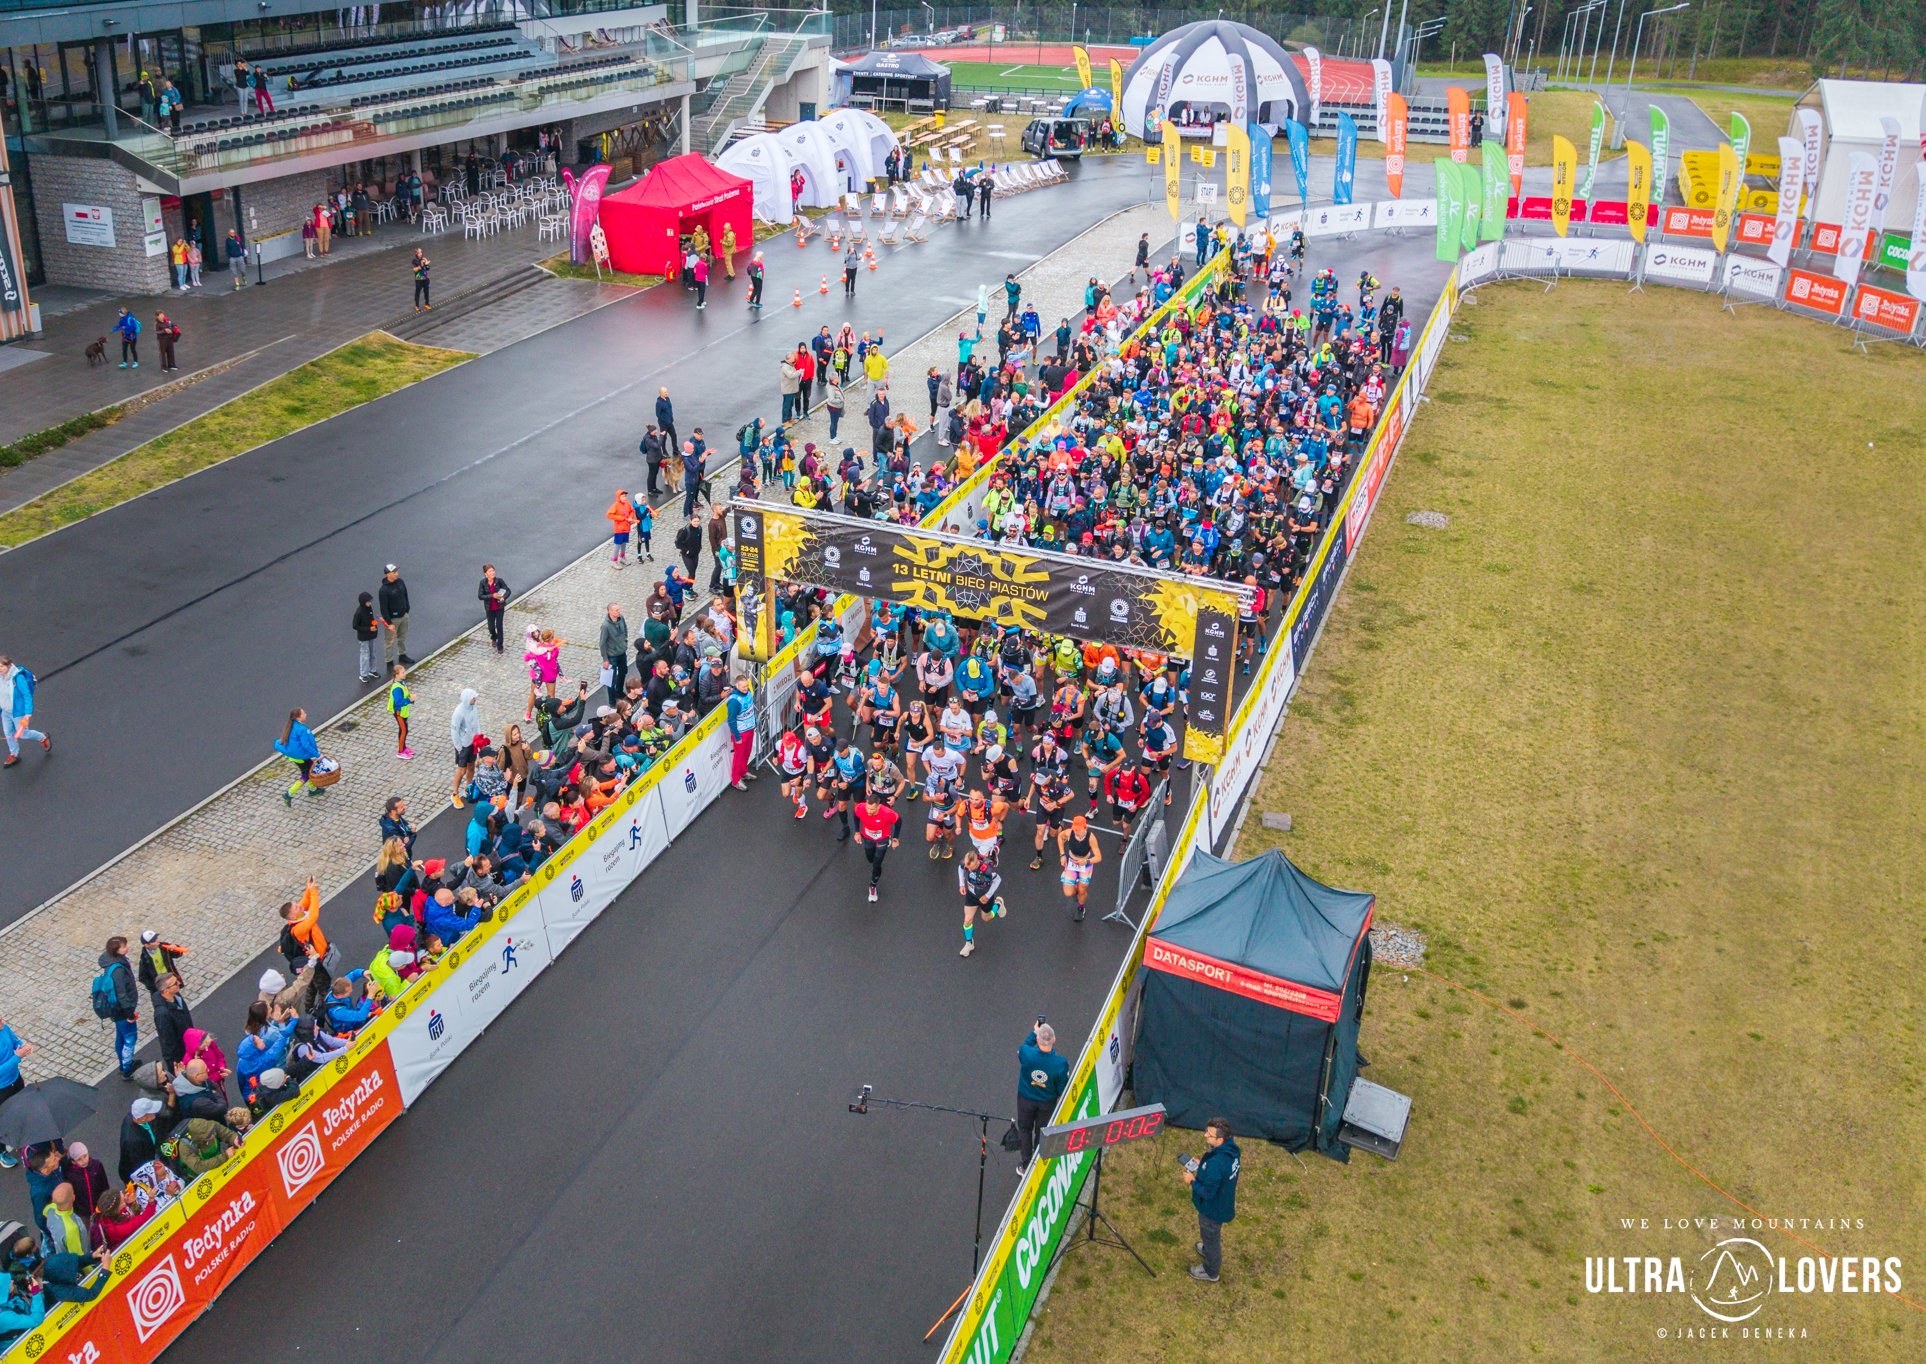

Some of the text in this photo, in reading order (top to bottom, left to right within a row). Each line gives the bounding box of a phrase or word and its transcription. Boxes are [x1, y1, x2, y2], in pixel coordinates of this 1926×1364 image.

[1159, 64, 1172, 100] KGHM
[1196, 75, 1228, 83] KGHM
[1263, 74, 1284, 82] KGHM
[1670, 256, 1707, 268] KGHM
[1887, 245, 1909, 260] COCO
[1744, 268, 1774, 282] KGHM
[1812, 282, 1839, 298] Jedynka
[1881, 299, 1910, 316] Jedynka
[854, 544, 876, 553] KGHM
[892, 564, 1049, 602] 13 LETNI BIEG PIASTÓW
[1070, 583, 1096, 593] KGHM
[1205, 628, 1224, 636] KGHM
[1275, 650, 1292, 682] KGHM
[1253, 699, 1270, 735] KGHM
[1221, 751, 1242, 793] KGHM
[603, 839, 626, 863] Biegajmy
[605, 856, 621, 874] razem
[1153, 946, 1234, 983] DATASPORT
[468, 961, 498, 992] Biegajmy
[1240, 980, 1262, 992] e-mail:
[471, 982, 490, 1003] razem
[322, 1070, 384, 1136] Jedynka
[332, 1098, 384, 1152] POLSKIE RADIO
[1105, 1113, 1162, 1144] 0:02
[183, 1190, 256, 1270] Jedynka
[194, 1220, 256, 1286] POLSKIE RADIO
